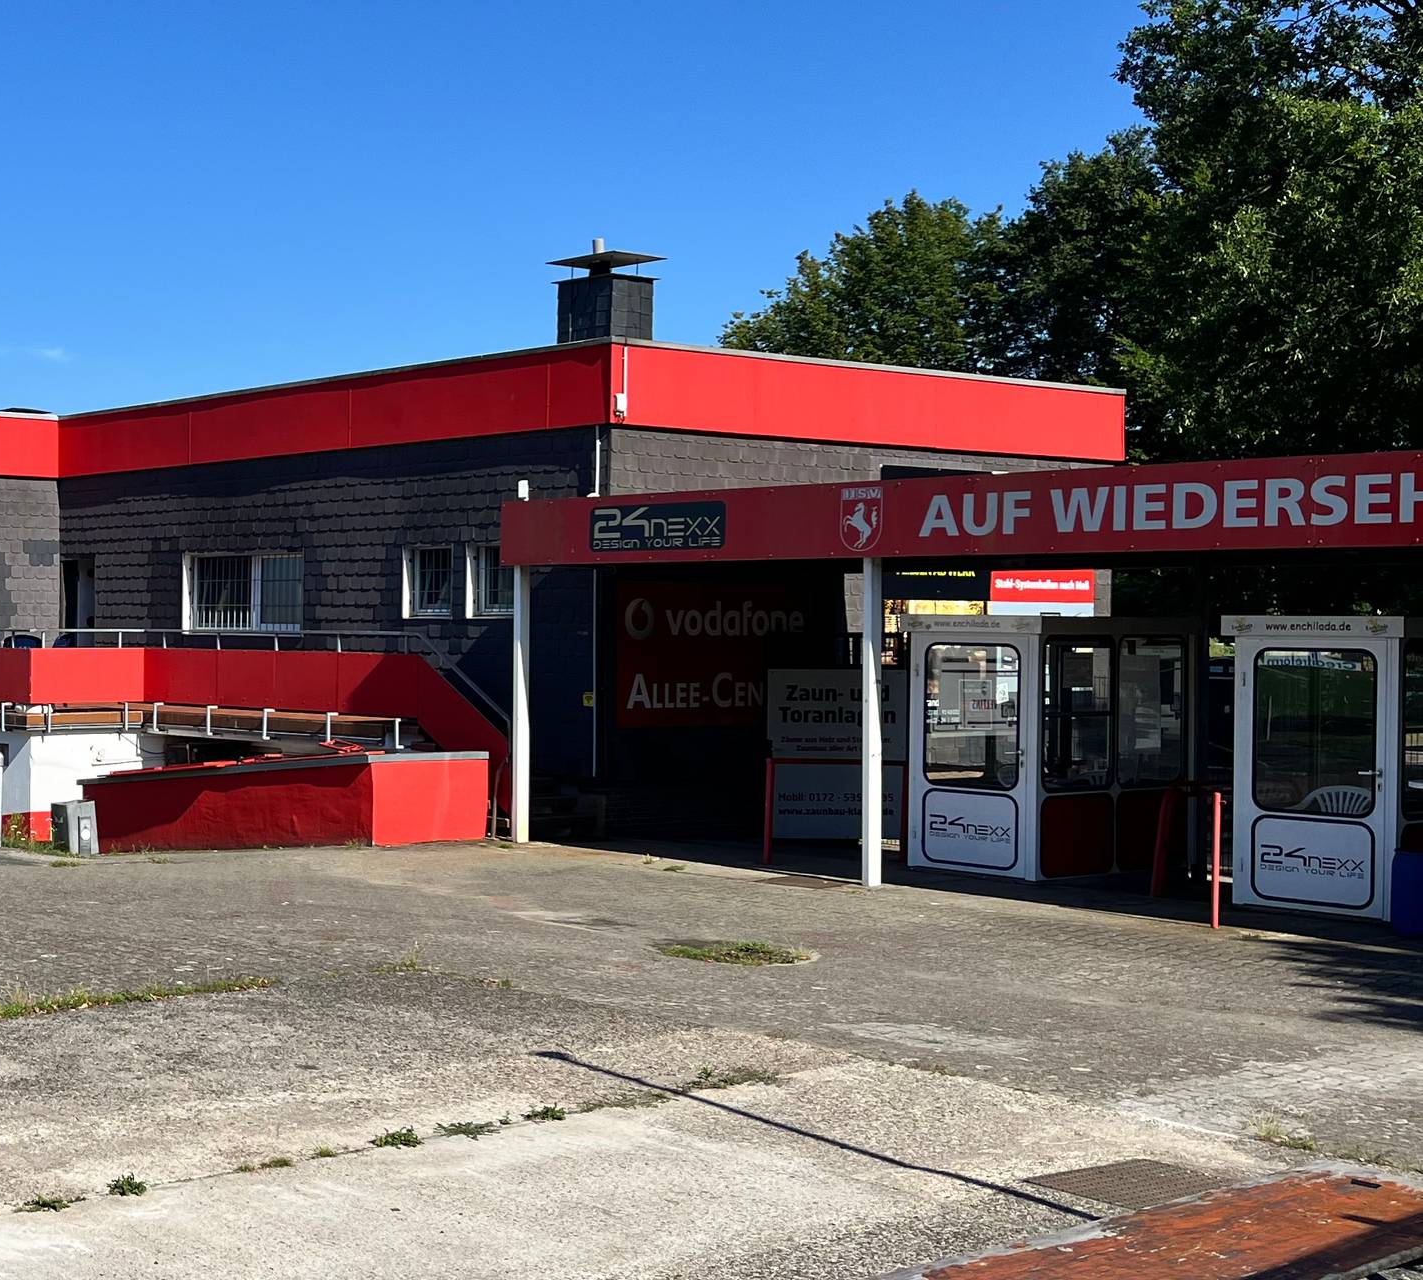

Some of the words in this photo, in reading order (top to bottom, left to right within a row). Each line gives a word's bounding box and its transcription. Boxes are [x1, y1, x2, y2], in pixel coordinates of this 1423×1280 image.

[918, 490, 1032, 537] AUF
[593, 539, 640, 549] DESIGN
[645, 538, 684, 548] YOUR
[688, 536, 721, 547] LIFE
[665, 600, 805, 637] vodafone
[1265, 621, 1352, 631] www.enchilada.de
[785, 684, 844, 702] Zaun-
[849, 684, 890, 702] ud
[808, 792, 835, 801] 0172
[929, 830, 960, 839] DESIGN
[1260, 863, 1300, 873] DESIGN
[1304, 868, 1335, 877] YOUR
[1338, 871, 1365, 880] LIFE
